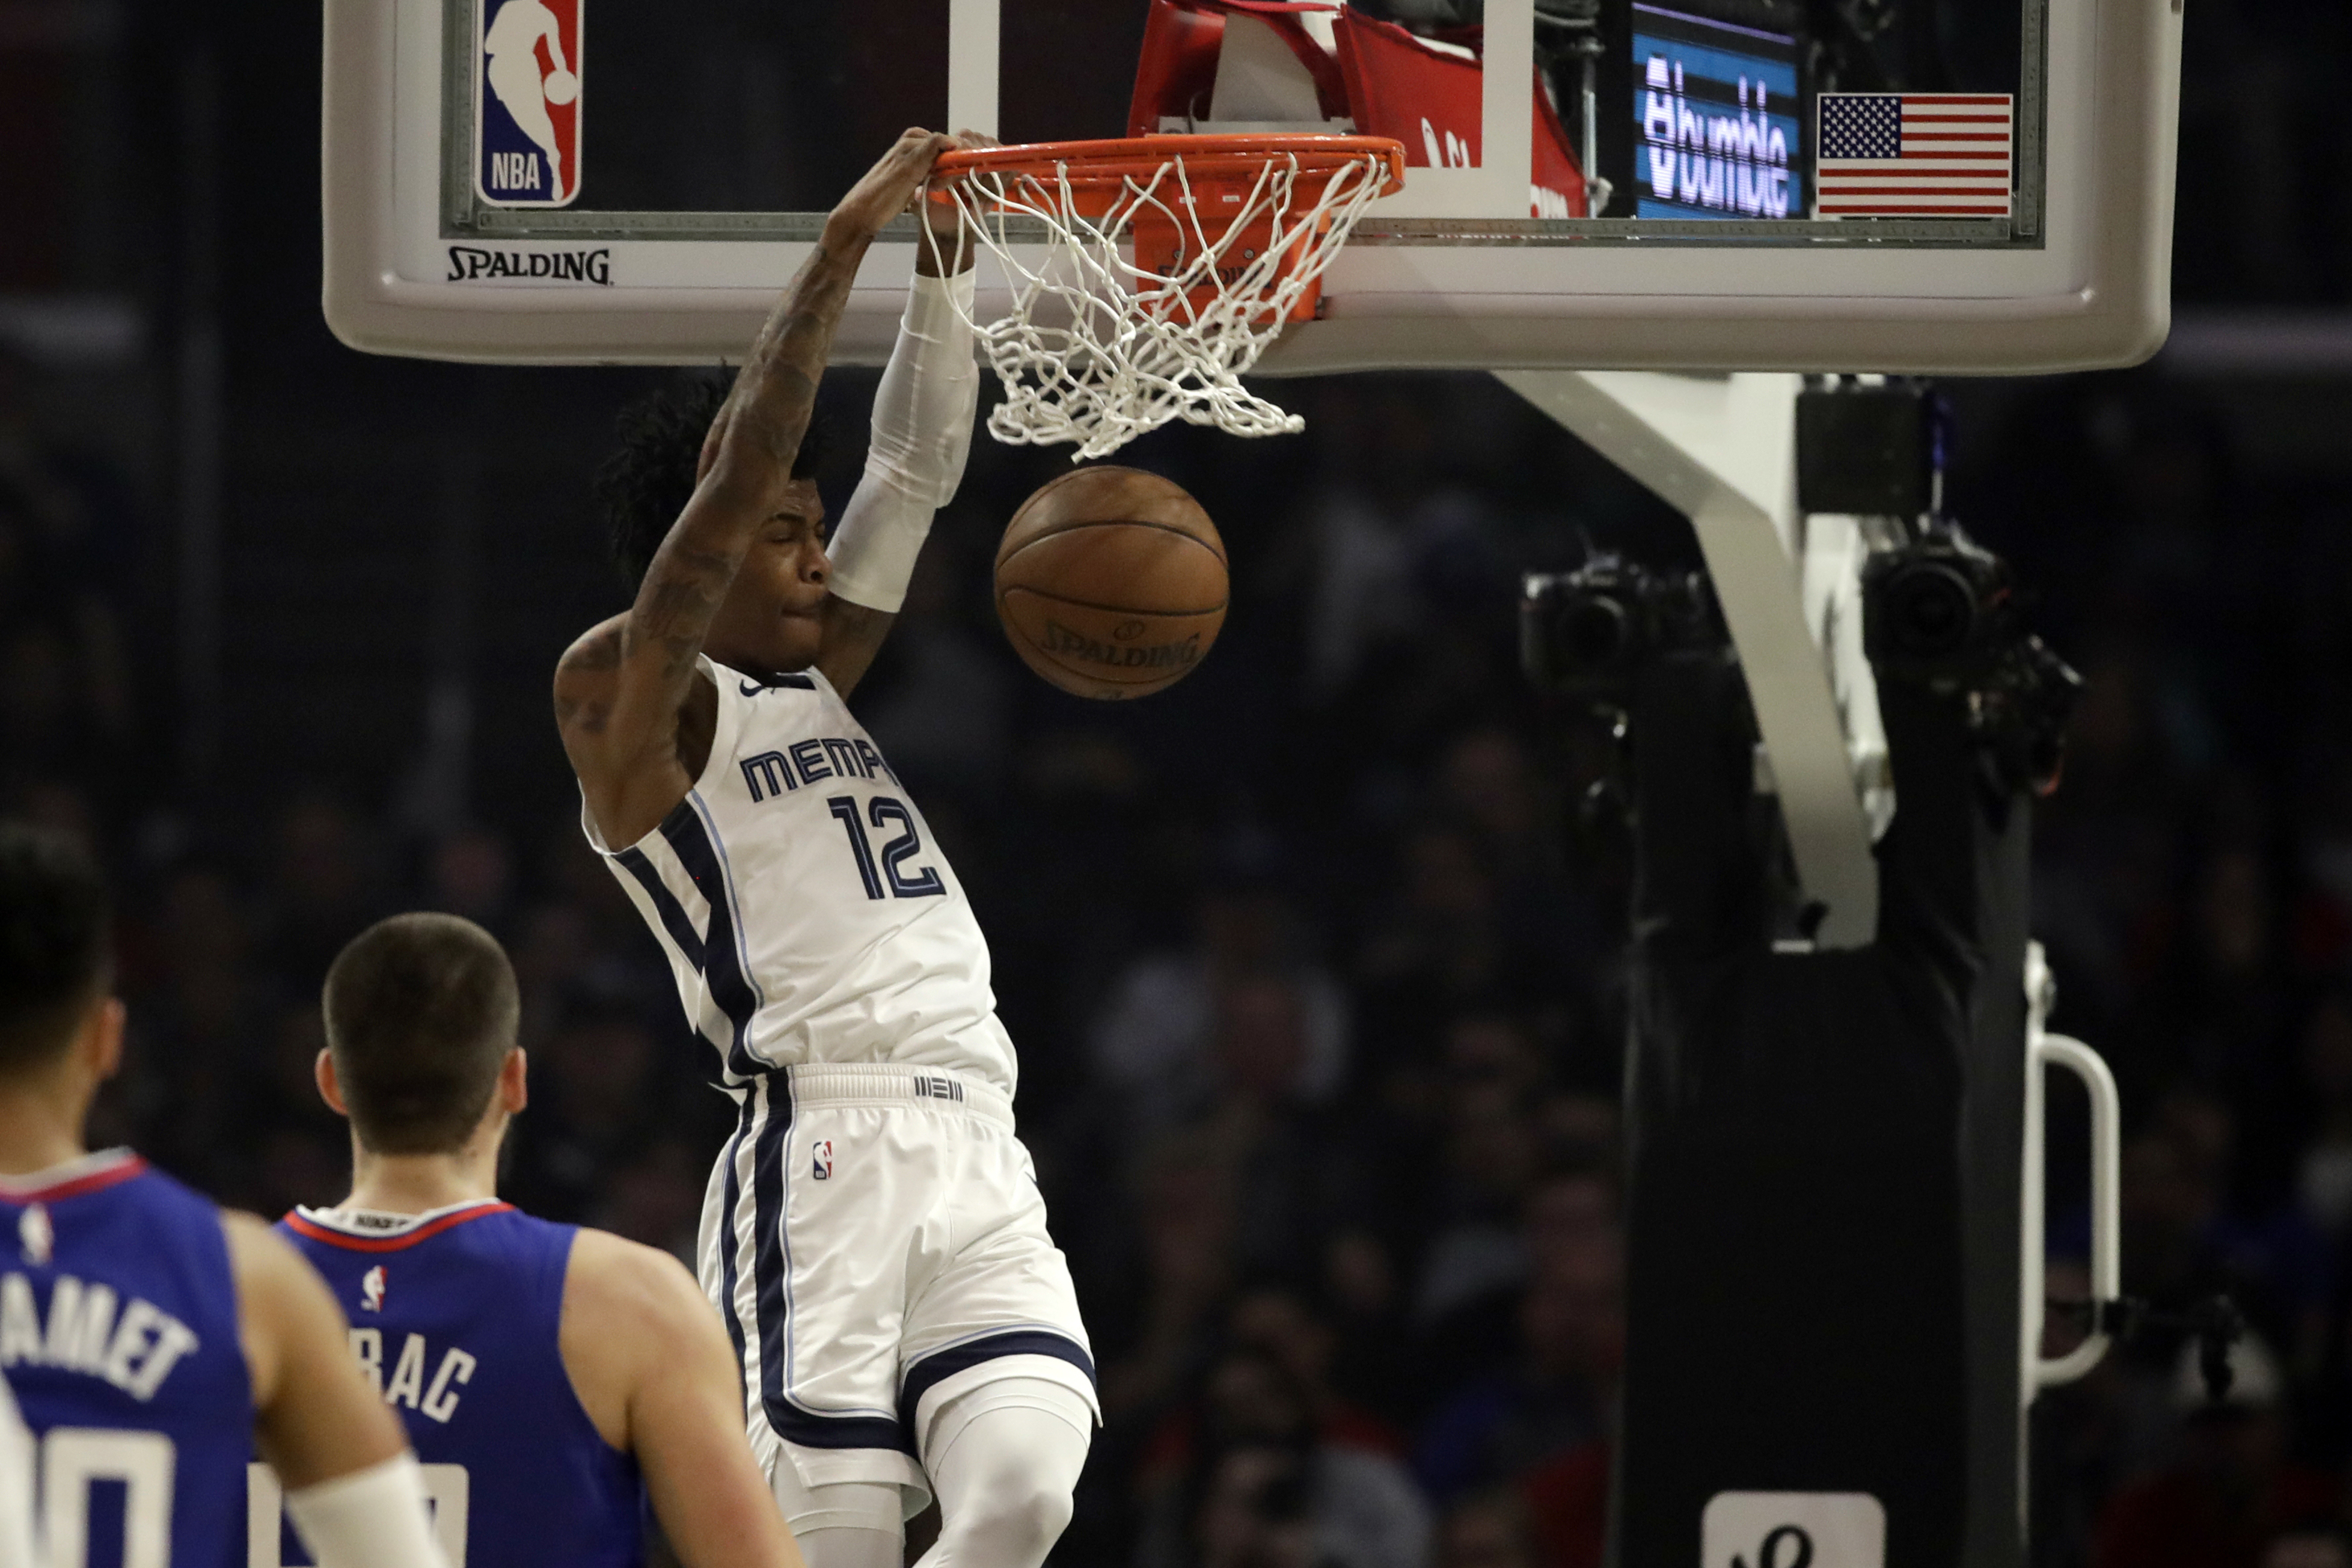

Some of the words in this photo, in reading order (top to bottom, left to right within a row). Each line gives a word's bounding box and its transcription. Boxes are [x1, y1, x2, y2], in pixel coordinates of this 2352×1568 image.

[492, 152, 541, 190] NBA
[448, 245, 612, 286] SPALDING
[1042, 622, 1200, 668] SPALDING
[740, 738, 900, 803] MEMP
[827, 796, 946, 900] 12
